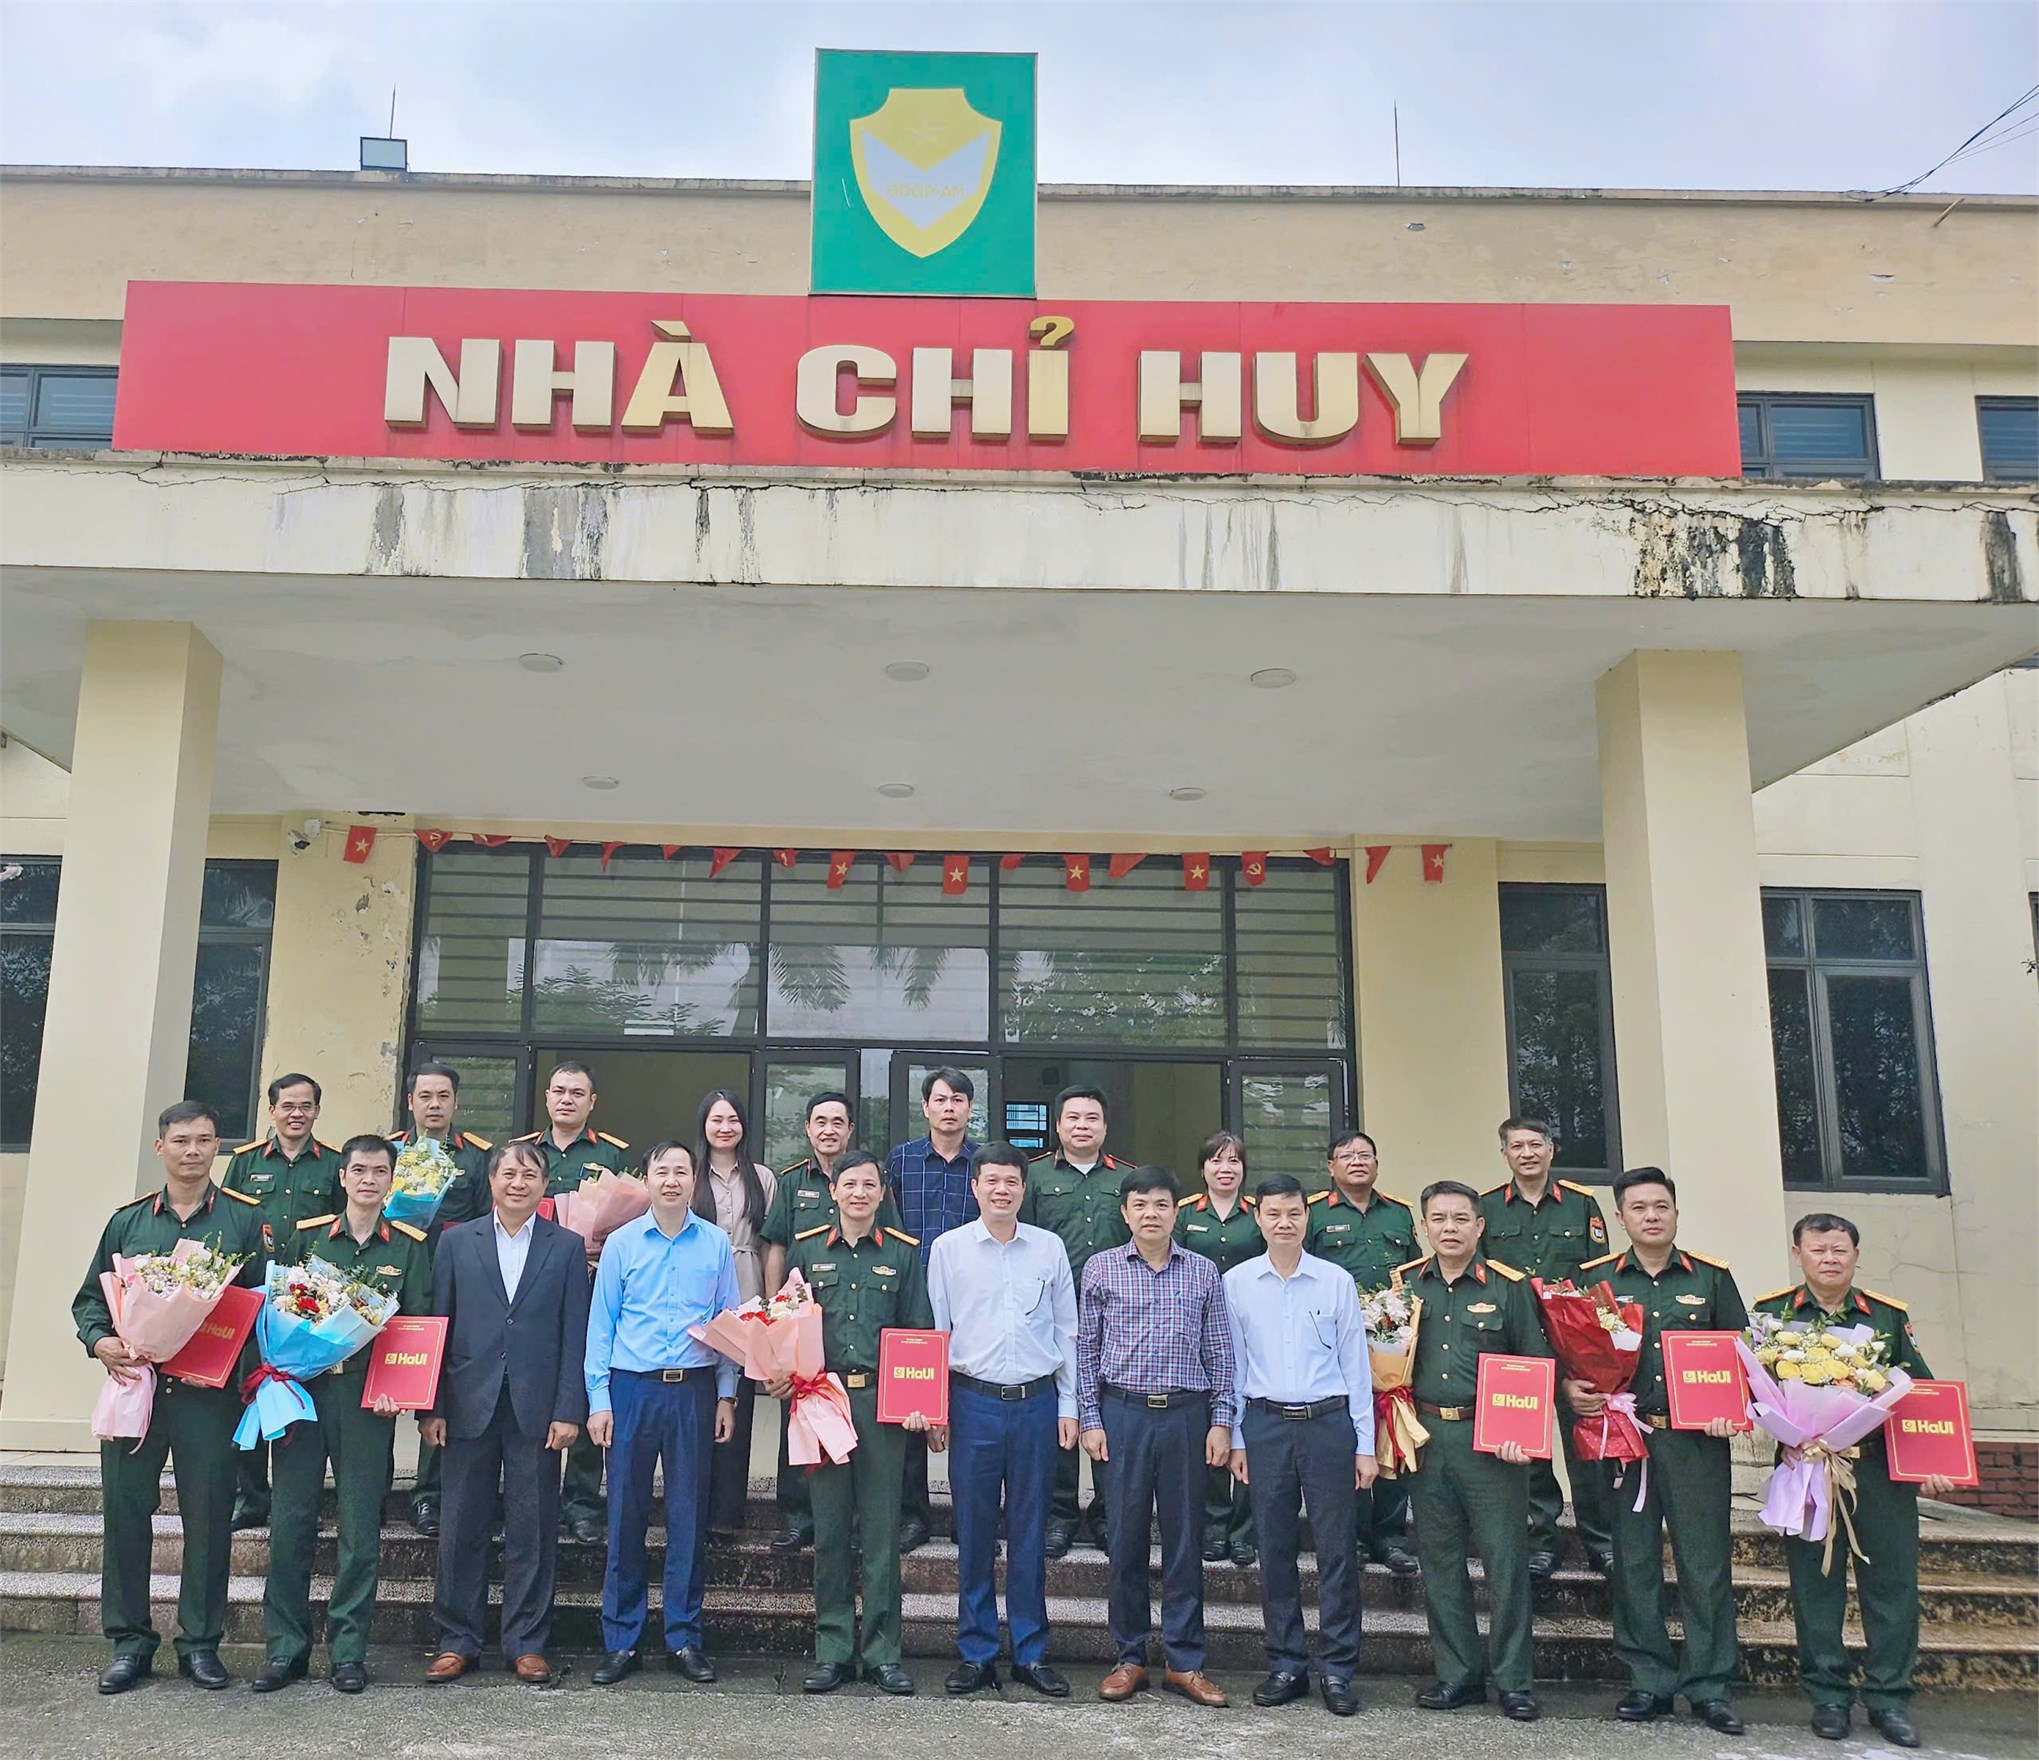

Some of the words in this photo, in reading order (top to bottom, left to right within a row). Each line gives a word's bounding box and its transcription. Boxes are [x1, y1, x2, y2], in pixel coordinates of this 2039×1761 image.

[384, 320, 735, 435] NHÀ
[796, 316, 1075, 442] CHỈ
[1137, 350, 1469, 445] HUY
[397, 1353, 428, 1365] HaUI
[905, 1367, 935, 1380] HaUI
[1696, 1370, 1731, 1384] HaUI
[1505, 1394, 1538, 1410] HaUI
[1917, 1420, 1955, 1435] HaUI
